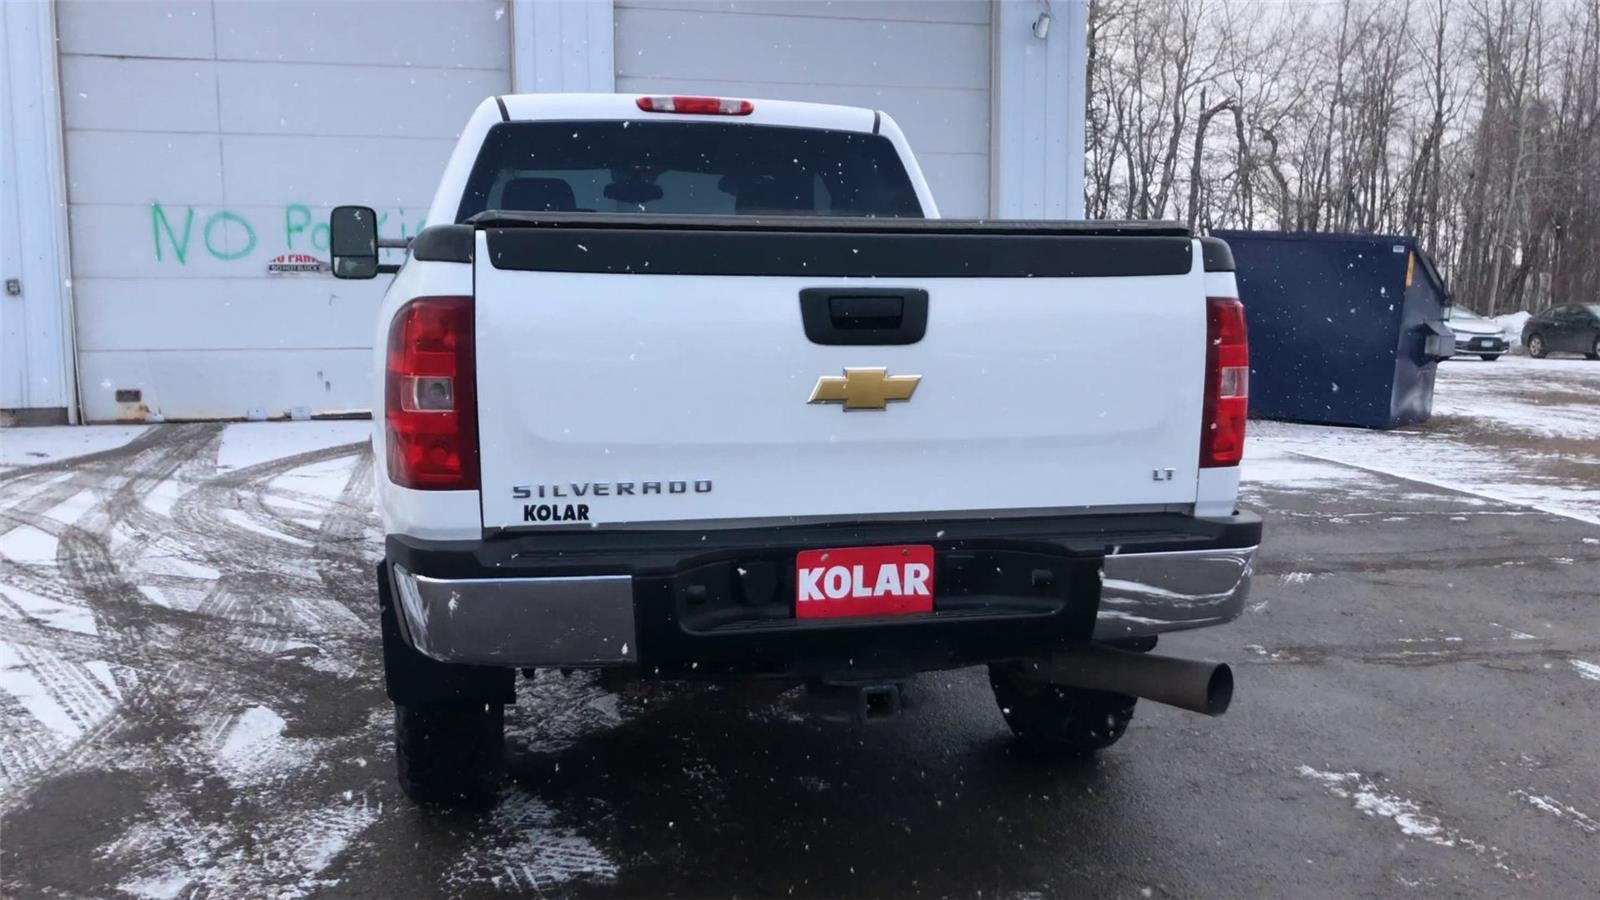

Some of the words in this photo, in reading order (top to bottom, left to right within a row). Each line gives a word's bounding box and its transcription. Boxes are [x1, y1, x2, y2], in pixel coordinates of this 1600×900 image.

[151, 201, 256, 265] NO
[1152, 468, 1176, 481] LT
[512, 479, 713, 499] SILVERADO
[523, 504, 590, 522] KOLAR
[798, 563, 930, 602] KOLAR
